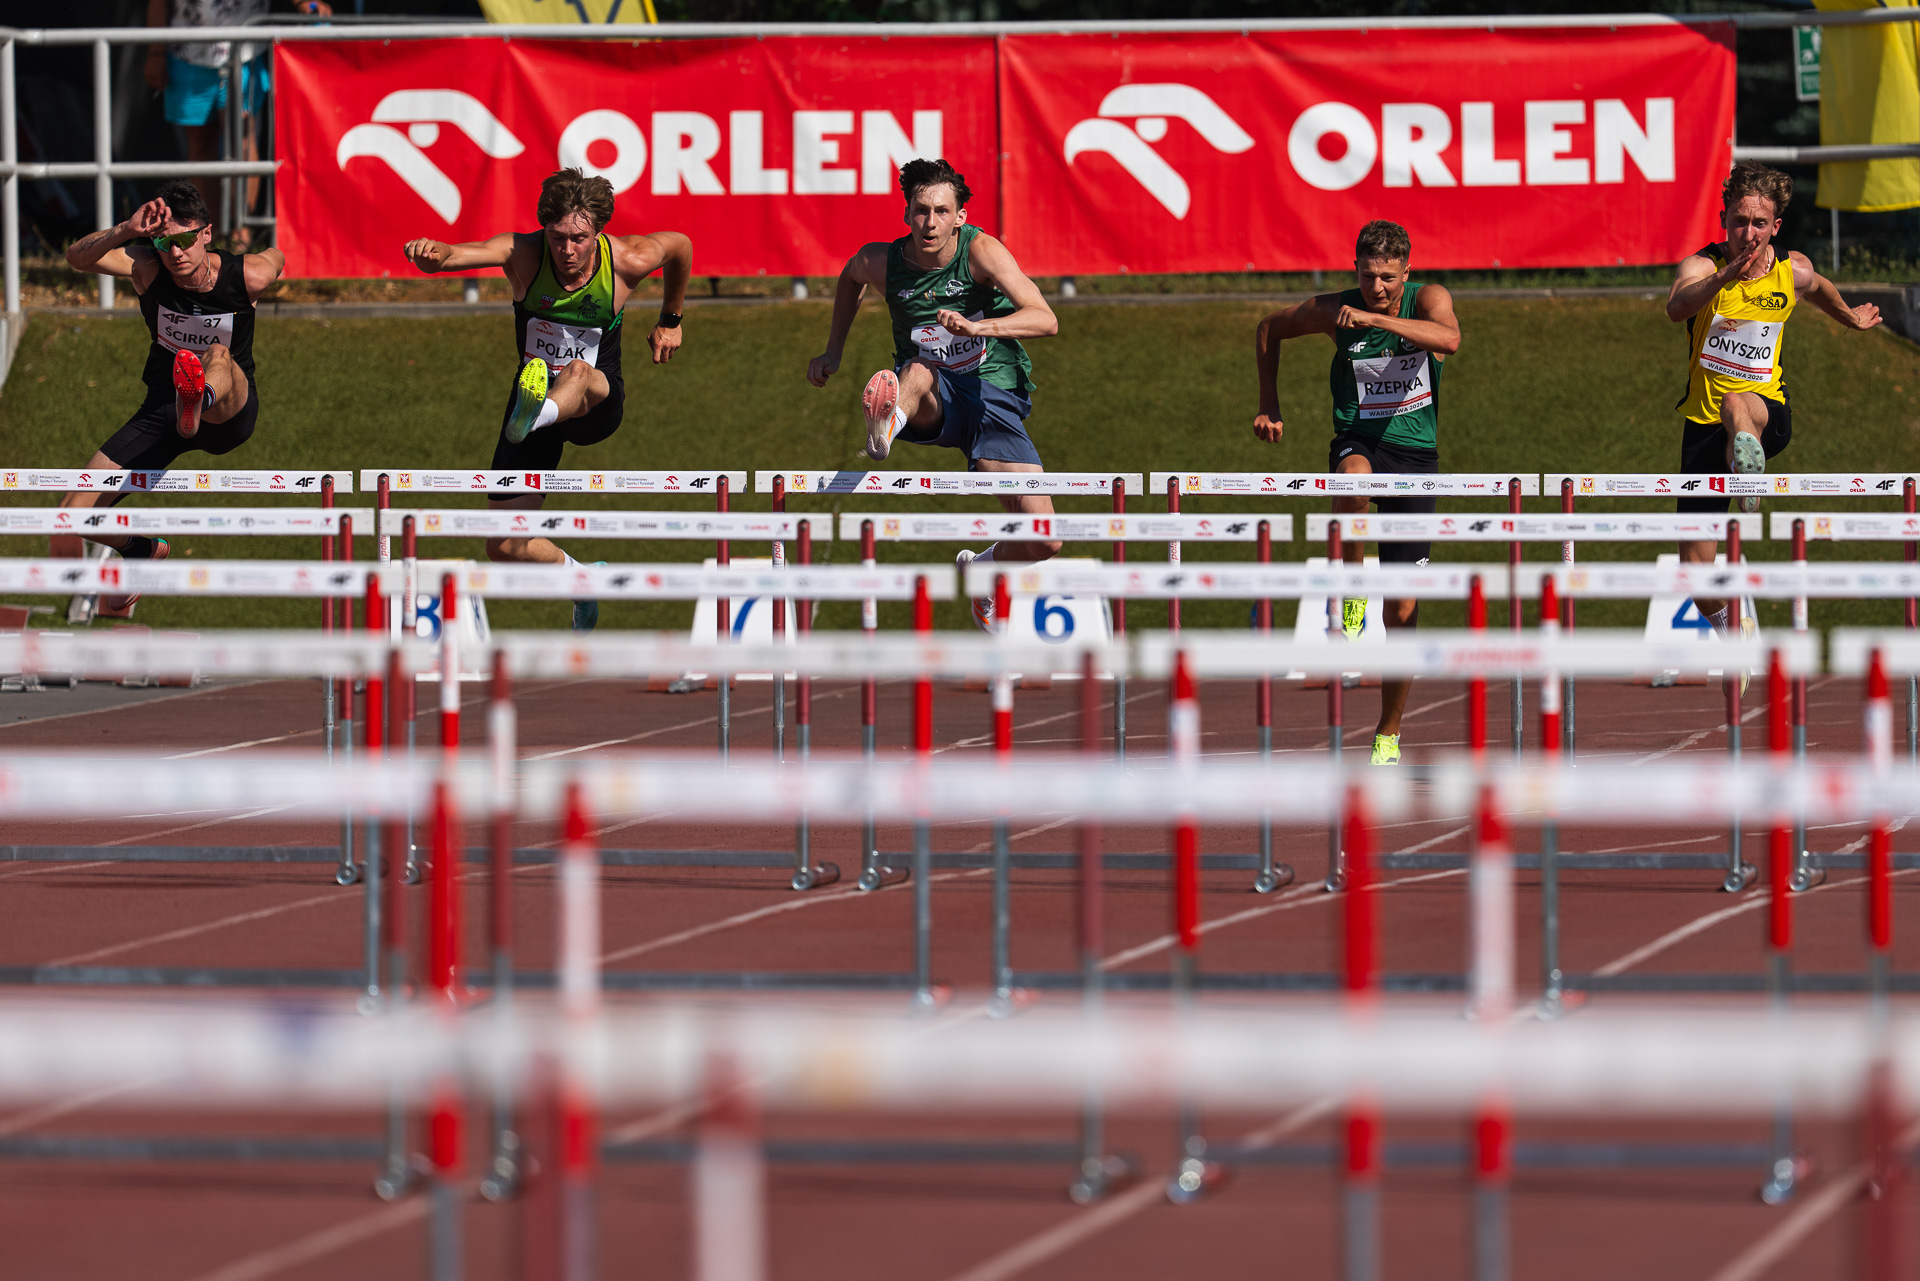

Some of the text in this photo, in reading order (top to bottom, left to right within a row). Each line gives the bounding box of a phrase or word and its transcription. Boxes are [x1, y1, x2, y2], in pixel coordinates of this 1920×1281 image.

[1288, 97, 1675, 190] ORLEN
[558, 108, 942, 196] ORLEN
[897, 289, 915, 299] 4F
[1760, 298, 1780, 308] OSA
[162, 313, 189, 324] 4F
[203, 318, 221, 328] 37
[165, 325, 221, 345] ŚCIRKA
[535, 327, 554, 336] ORLEN
[577, 330, 586, 338] 7
[1761, 326, 1769, 337] 3
[536, 338, 586, 360] POLAK
[1347, 342, 1367, 353] 4F
[1708, 336, 1771, 360] ONYSZKO
[1400, 357, 1417, 371] 22
[1708, 362, 1747, 379] WARSZAWA
[1364, 376, 1423, 395] RZEPKA
[1369, 401, 1423, 416] WARSZAWA 2026
[103, 475, 123, 486] 4F
[295, 477, 315, 487] 4F
[497, 476, 517, 486] 4F
[690, 478, 710, 488] 4F
[892, 478, 912, 488] 4F
[1286, 479, 1307, 489] 4F
[1681, 480, 1701, 490] 4F
[1876, 480, 1896, 490] 4F
[1033, 594, 1075, 644] 6
[1671, 595, 1713, 641] 4
